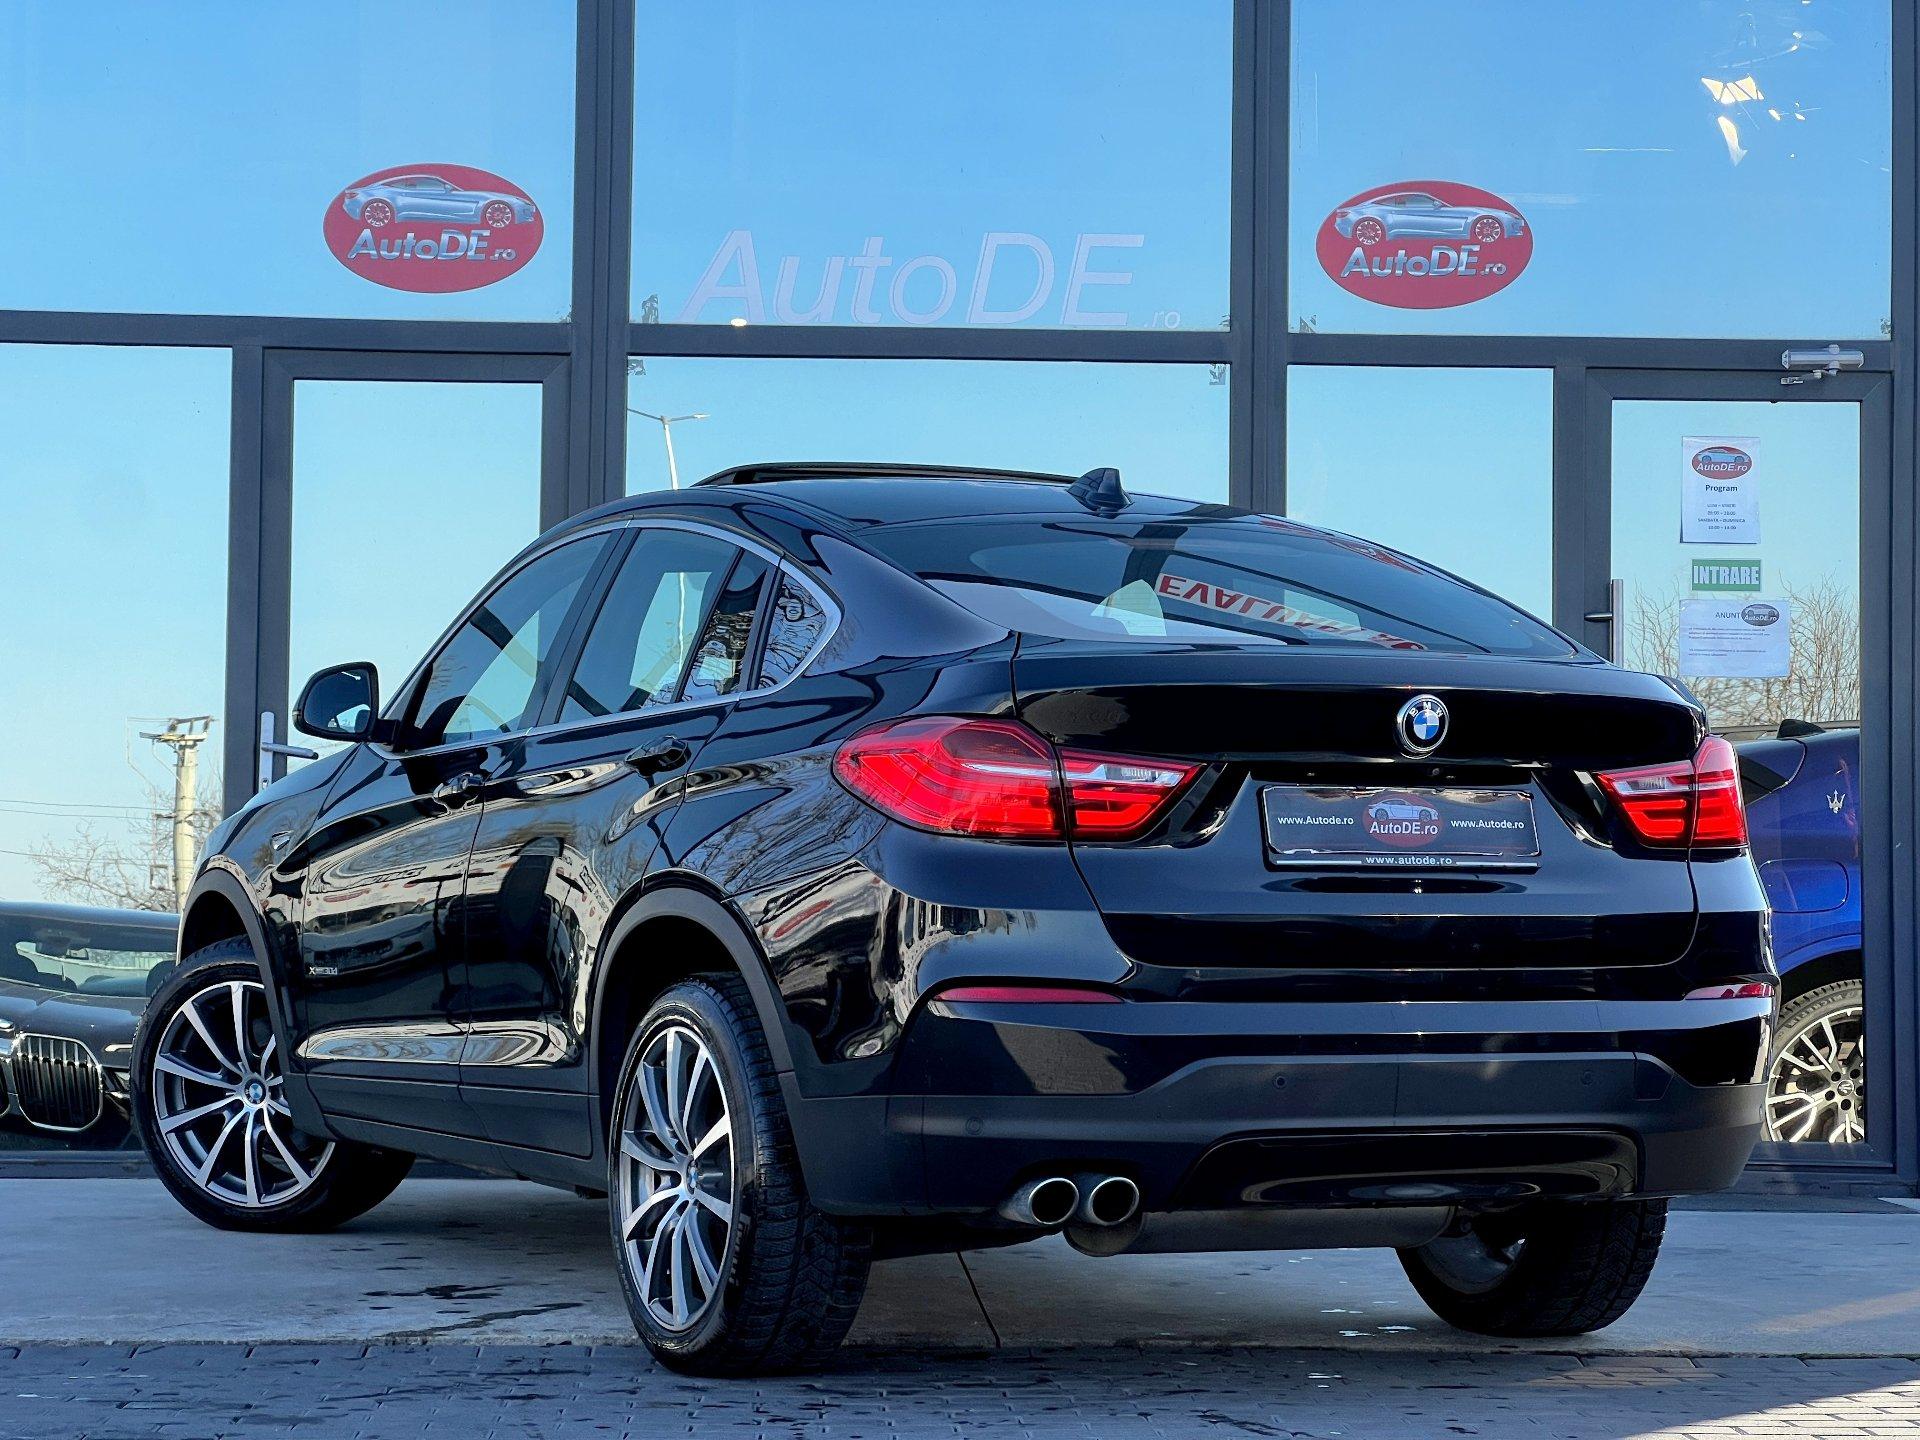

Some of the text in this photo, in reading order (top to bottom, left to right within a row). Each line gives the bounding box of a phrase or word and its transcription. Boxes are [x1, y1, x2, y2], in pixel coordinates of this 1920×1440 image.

[1696, 462, 1748, 472] AutoDE.ro
[1705, 484, 1738, 493] Program
[1693, 565, 1760, 585] INTRARE
[1715, 611, 1741, 620] ANUNT
[1408, 701, 1444, 718] BMW
[1277, 815, 1525, 836] www.Autode.ro AutoDE.ro www.Autode.ro
[1366, 855, 1453, 866] www.autode.ro
